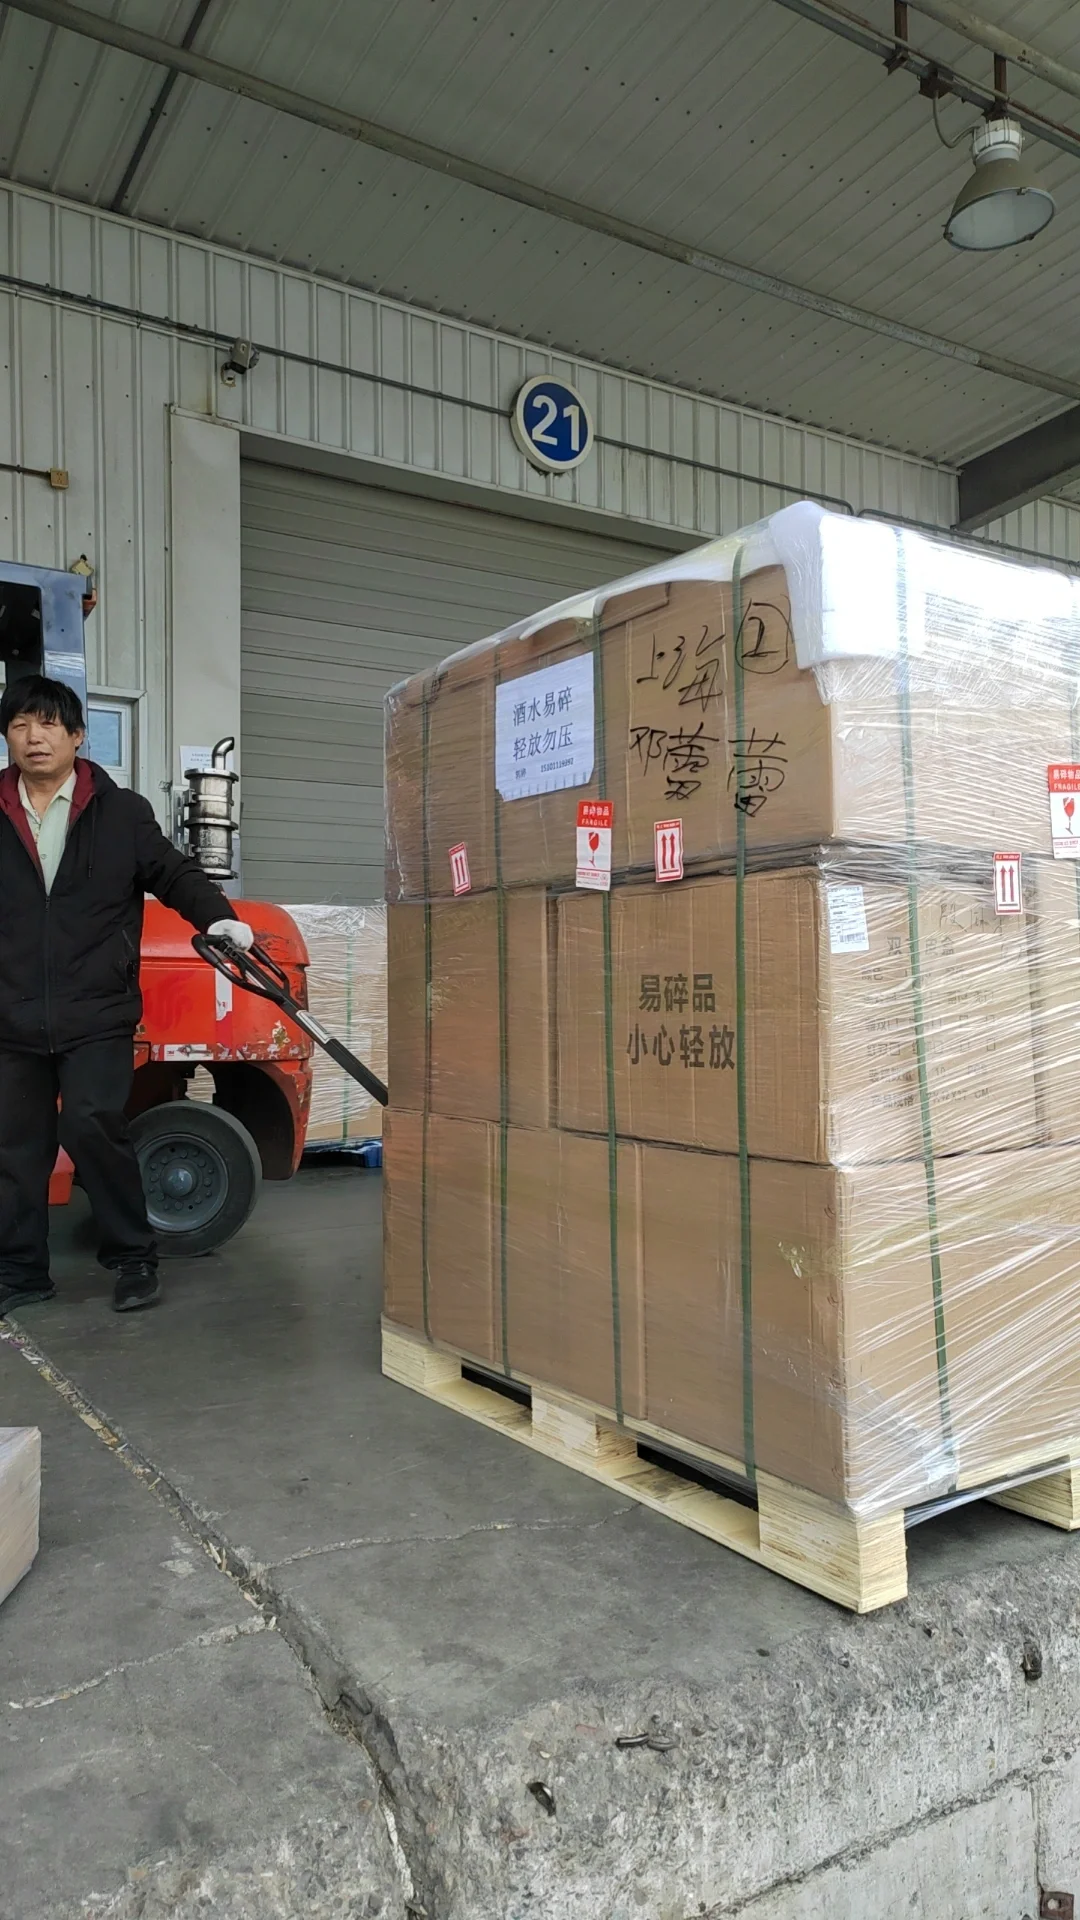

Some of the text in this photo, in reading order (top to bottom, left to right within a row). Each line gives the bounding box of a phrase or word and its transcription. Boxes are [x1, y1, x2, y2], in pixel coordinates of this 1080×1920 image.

[532, 394, 580, 452] 21
[513, 686, 573, 727] 酒水易碎
[513, 722, 573, 761] 轻放勿压
[638, 973, 716, 1013] 易碎品
[626, 1023, 735, 1070] 小心轻放
